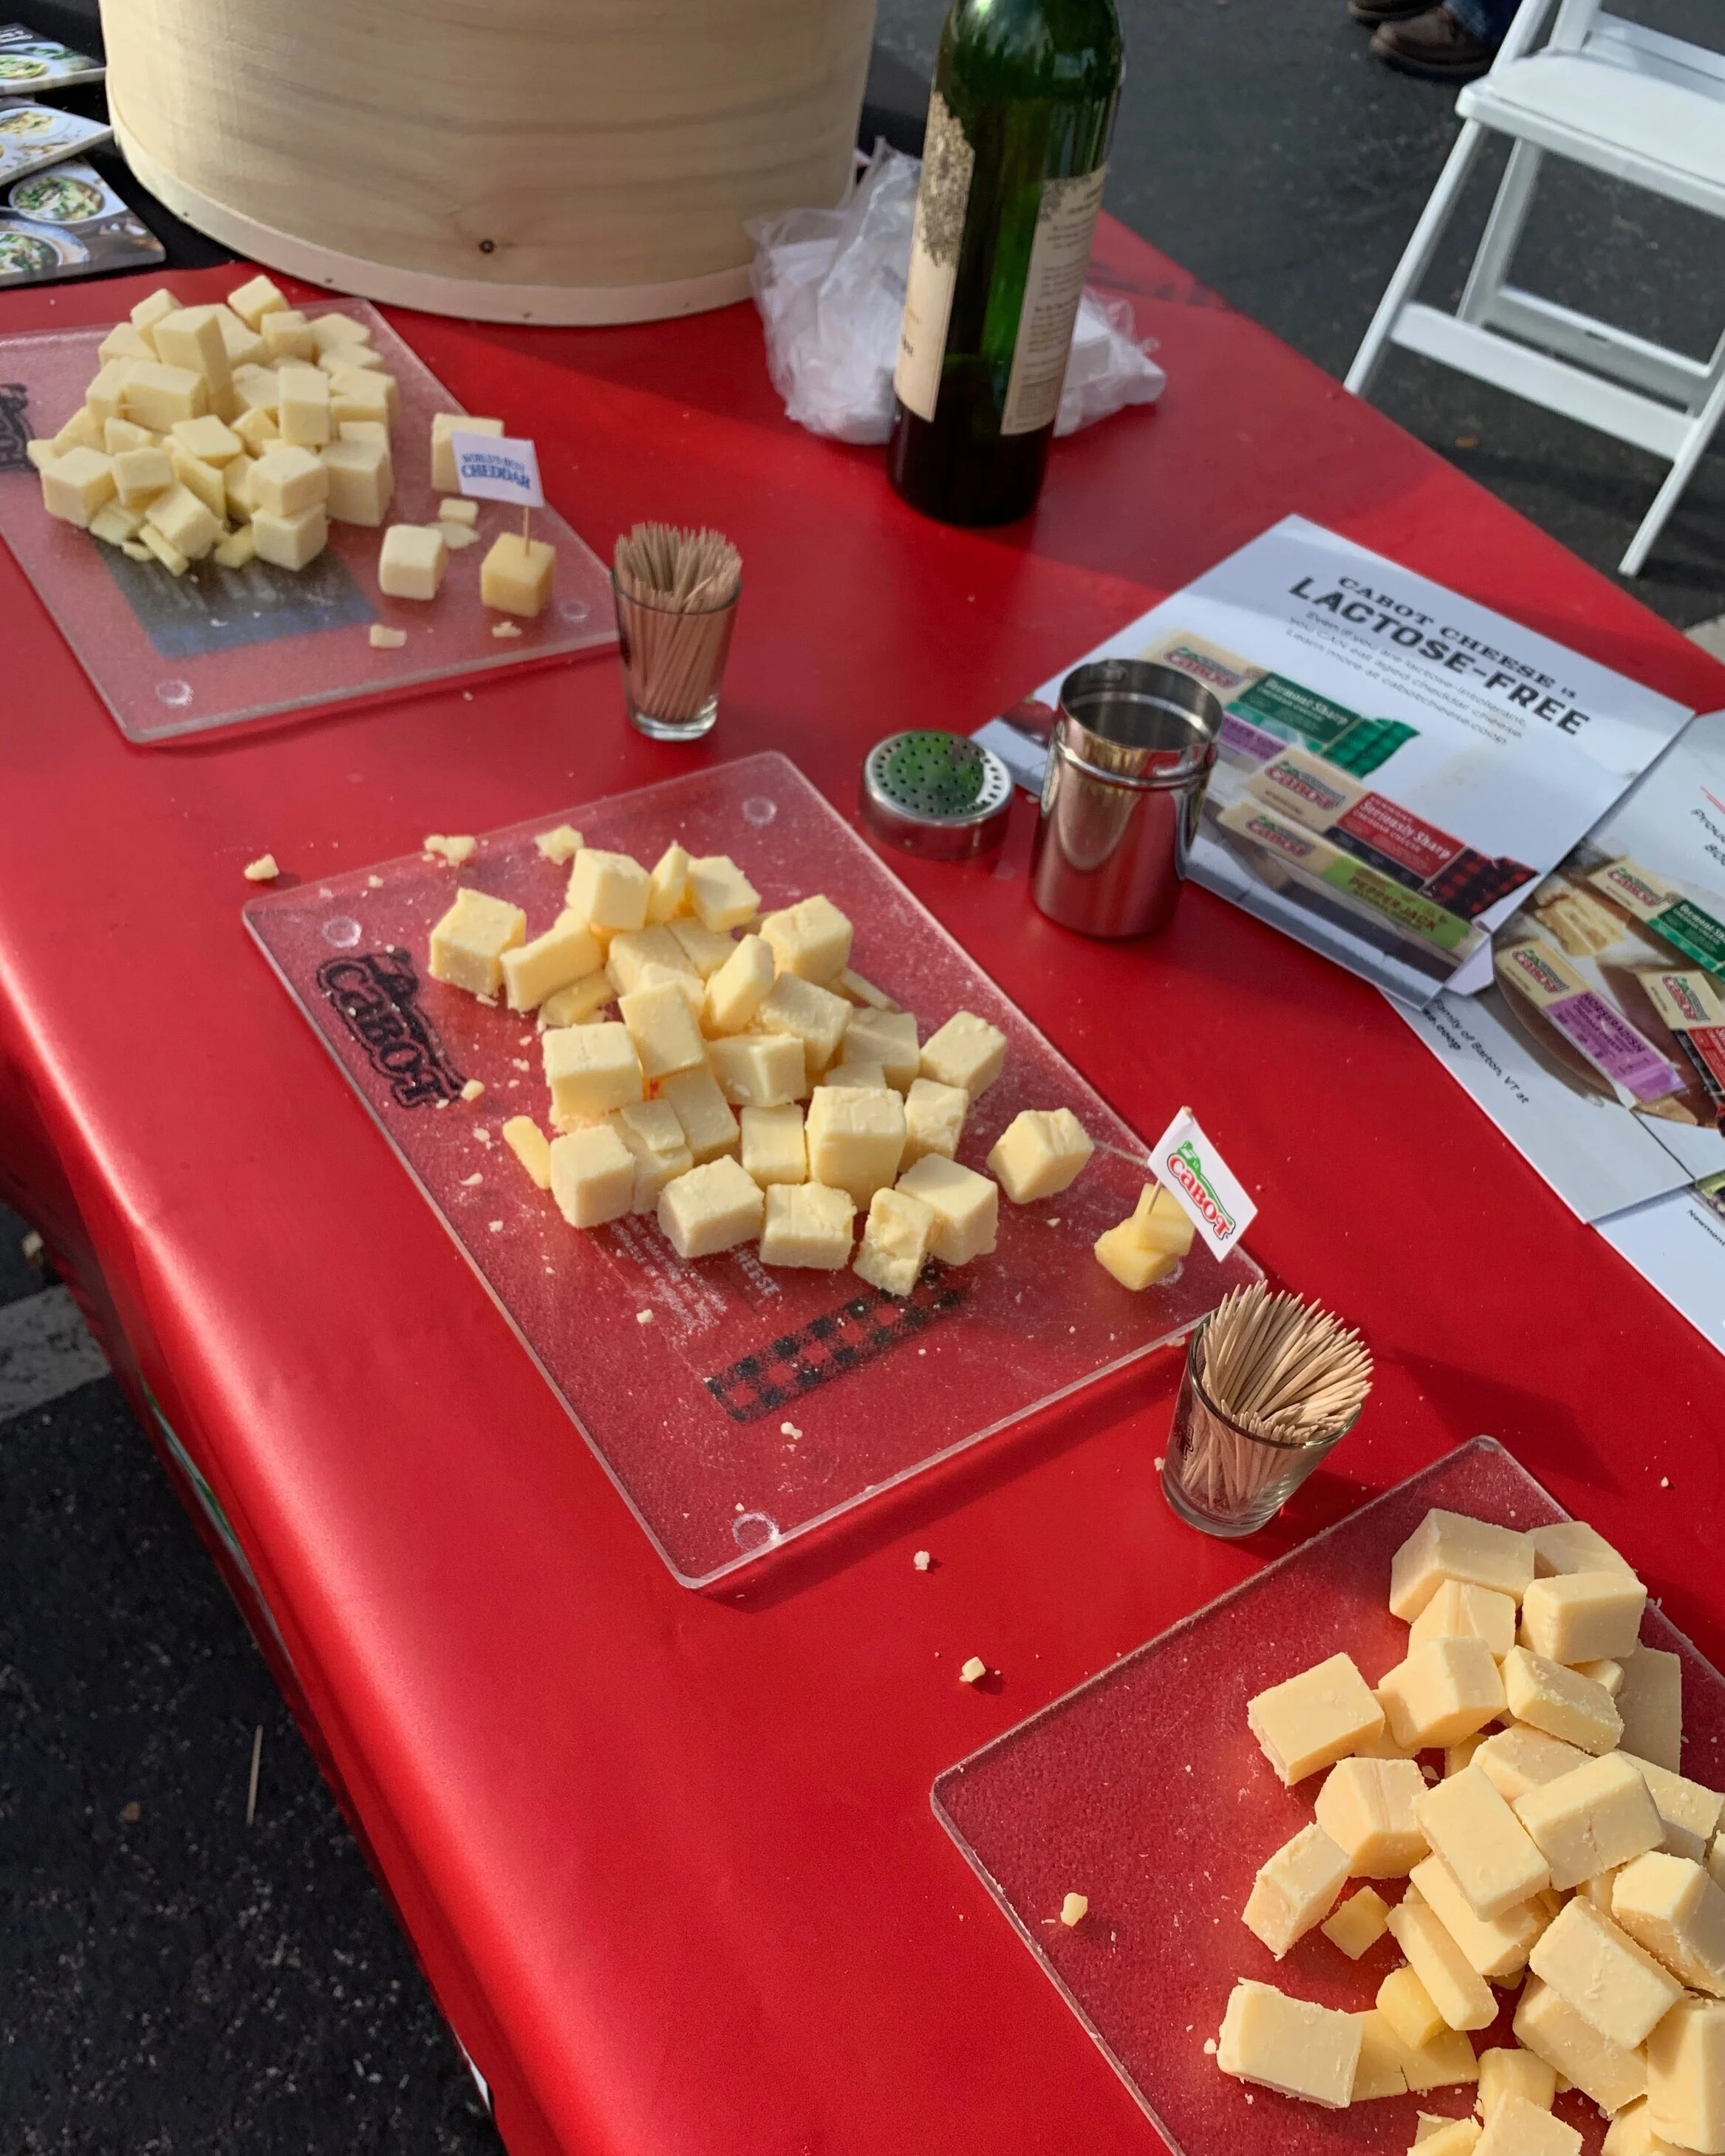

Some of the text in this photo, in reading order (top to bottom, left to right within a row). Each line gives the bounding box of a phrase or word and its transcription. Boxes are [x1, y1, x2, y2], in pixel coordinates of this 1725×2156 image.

[461, 465, 530, 489] CHEDDAR
[1339, 576, 1435, 626] CABOT
[1439, 627, 1557, 689] CHEESE
[1288, 576, 1591, 736] LACTOSE-FREE
[1413, 831, 1452, 860] Sharp
[1504, 1076, 1520, 1090] VT
[1516, 1092, 1529, 1103] at
